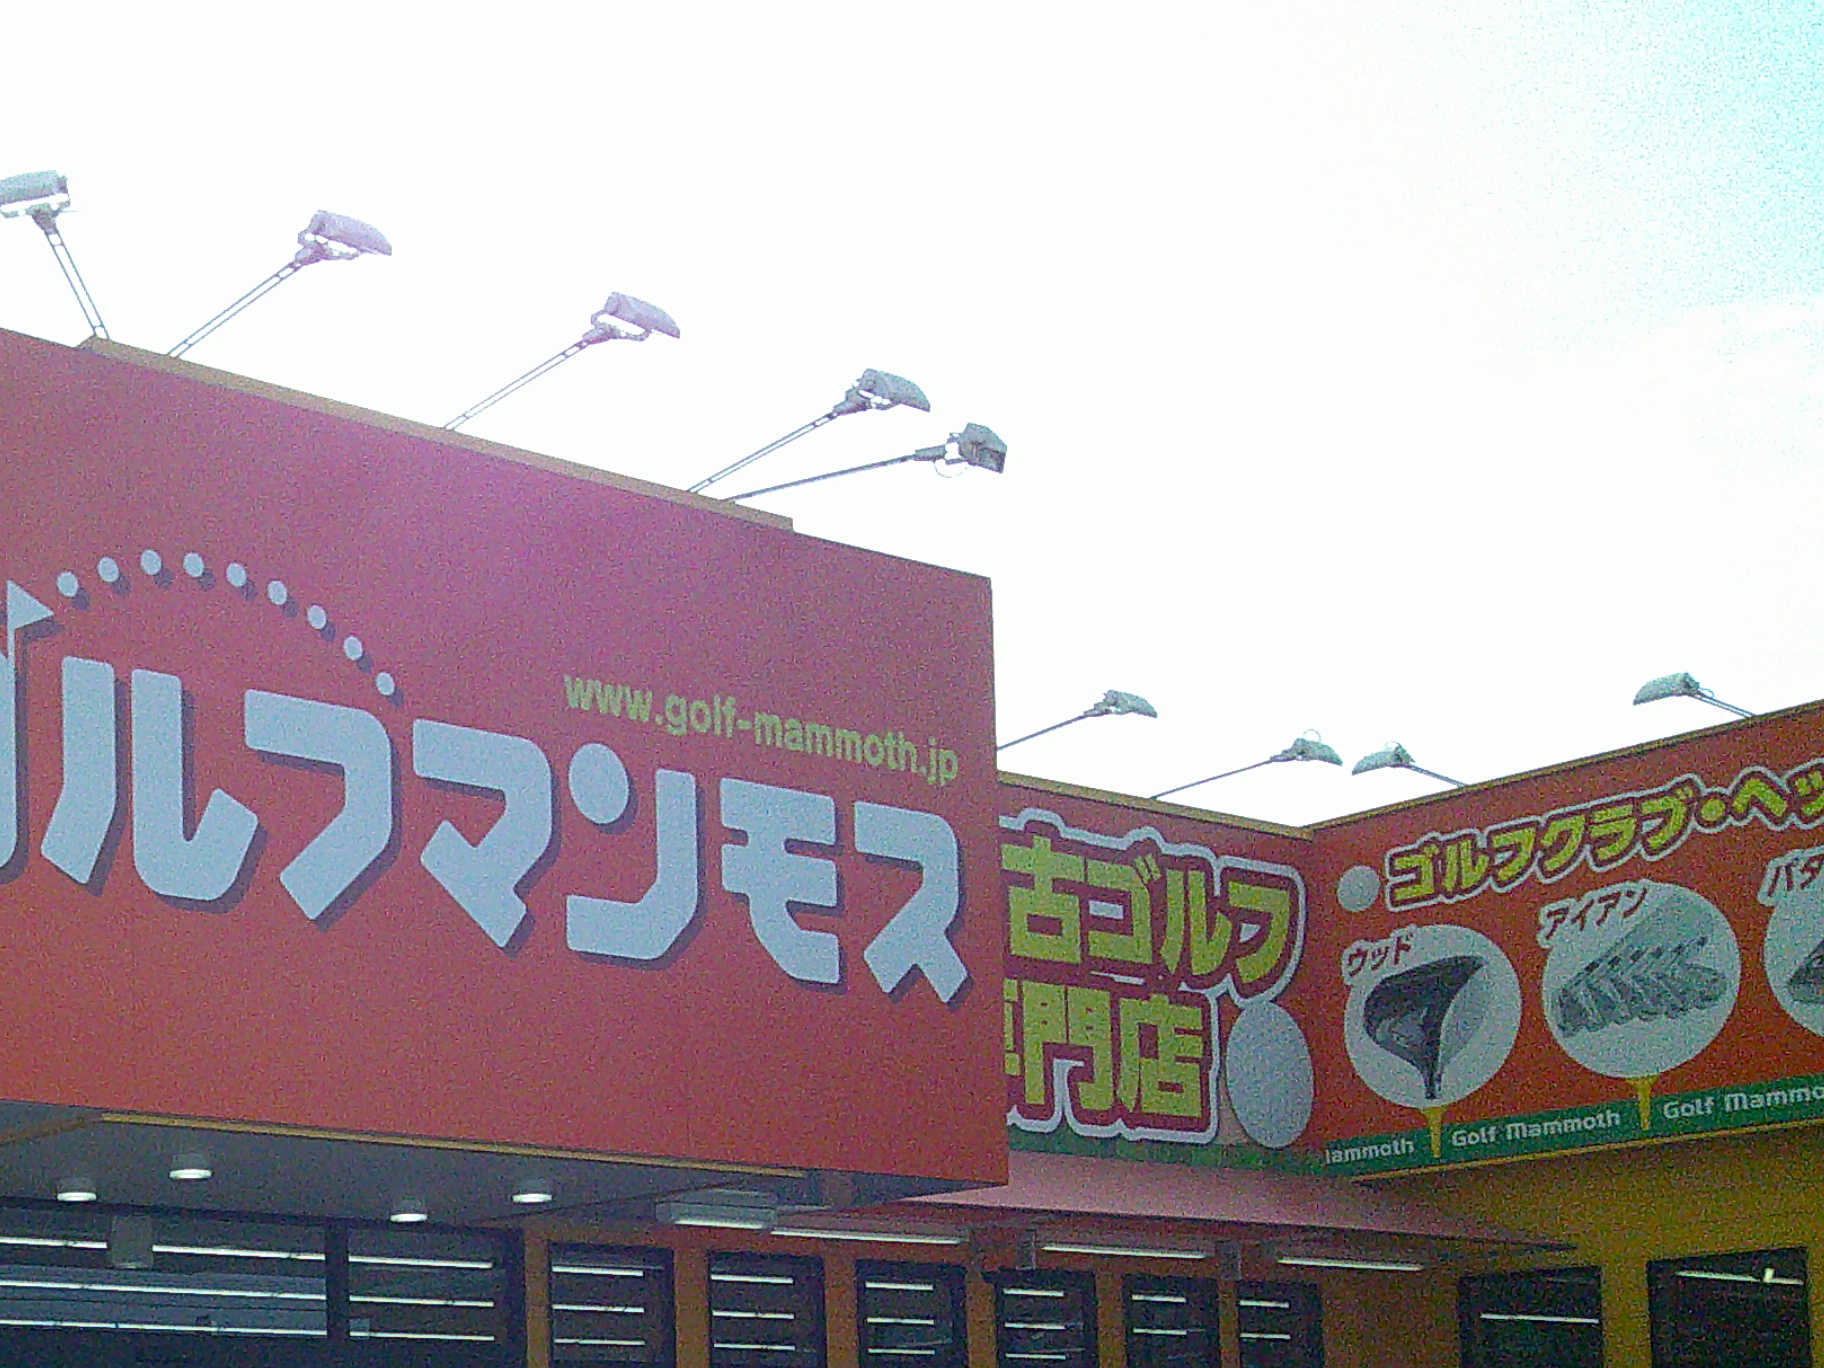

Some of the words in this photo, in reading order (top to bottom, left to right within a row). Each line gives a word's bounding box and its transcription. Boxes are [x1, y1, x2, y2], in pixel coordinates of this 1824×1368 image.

[562, 669, 961, 788] www.golf-mammoth.jp
[1545, 886, 1649, 940] アイアン
[1347, 931, 1414, 978] ウッド
[1002, 977, 1204, 1118] 門店
[1451, 1126, 1498, 1149] Golf
[1505, 1109, 1621, 1142] Mammoth
[1662, 1097, 1715, 1121] Golf
[1325, 1138, 1415, 1166] ammoth
